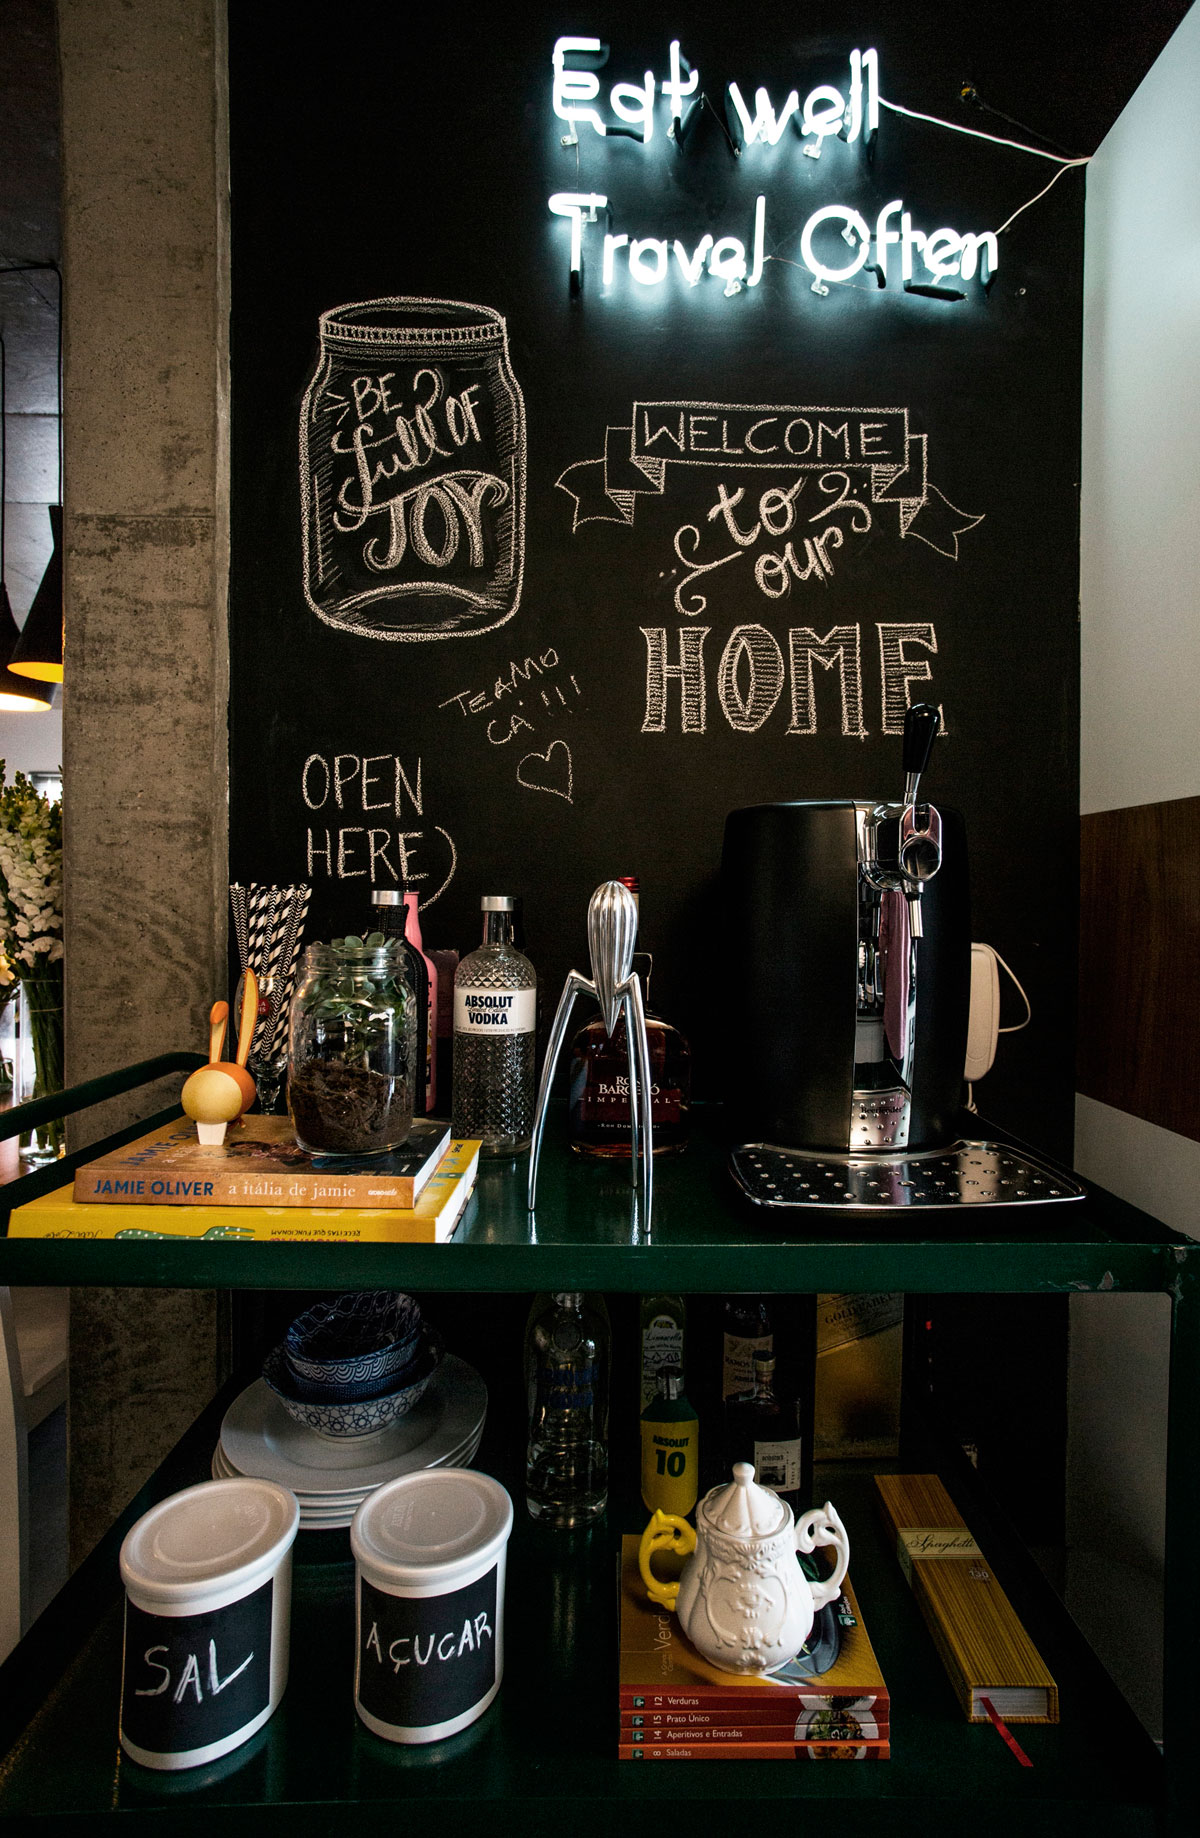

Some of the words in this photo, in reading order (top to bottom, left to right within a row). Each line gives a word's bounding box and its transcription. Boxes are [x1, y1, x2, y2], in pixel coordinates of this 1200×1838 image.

[552, 36, 699, 145] Eat
[729, 48, 879, 145] well
[548, 193, 766, 289] Travel
[801, 200, 998, 286] Often
[353, 372, 403, 422] BE
[446, 384, 482, 447] OF
[643, 410, 892, 459] WELCOME
[363, 470, 510, 574] JOY
[707, 476, 808, 546] to
[754, 527, 844, 599] our
[639, 622, 948, 740] HOME
[302, 753, 423, 818] OPEN
[307, 826, 429, 882] HERE
[464, 994, 513, 1008] ABSOLUT
[468, 1012, 508, 1025] VODKA
[588, 1096, 671, 1104] IMPEAL
[93, 1180, 145, 1195] JAMIE
[151, 1180, 213, 1196] OLIVER
[228, 1185, 238, 1195] a
[243, 1181, 282, 1196] itália
[289, 1183, 307, 1196] de
[311, 1184, 356, 1200] jamie
[653, 1434, 690, 1448] ABSOLUT
[655, 1449, 686, 1478] 10
[906, 1532, 974, 1554] Spaghetti
[366, 1611, 492, 1675] AÇUCAR
[135, 1638, 254, 1704] SAL
[653, 1715, 662, 1724] 15
[666, 1715, 687, 1723] Prato
[688, 1712, 710, 1722] Único
[654, 1696, 663, 1706] 12
[667, 1696, 699, 1705] Verduras
[653, 1730, 662, 1739] 14
[667, 1730, 704, 1740] Aperitivos
[712, 1729, 743, 1738] Entradas
[666, 1748, 692, 1757] Saladas
